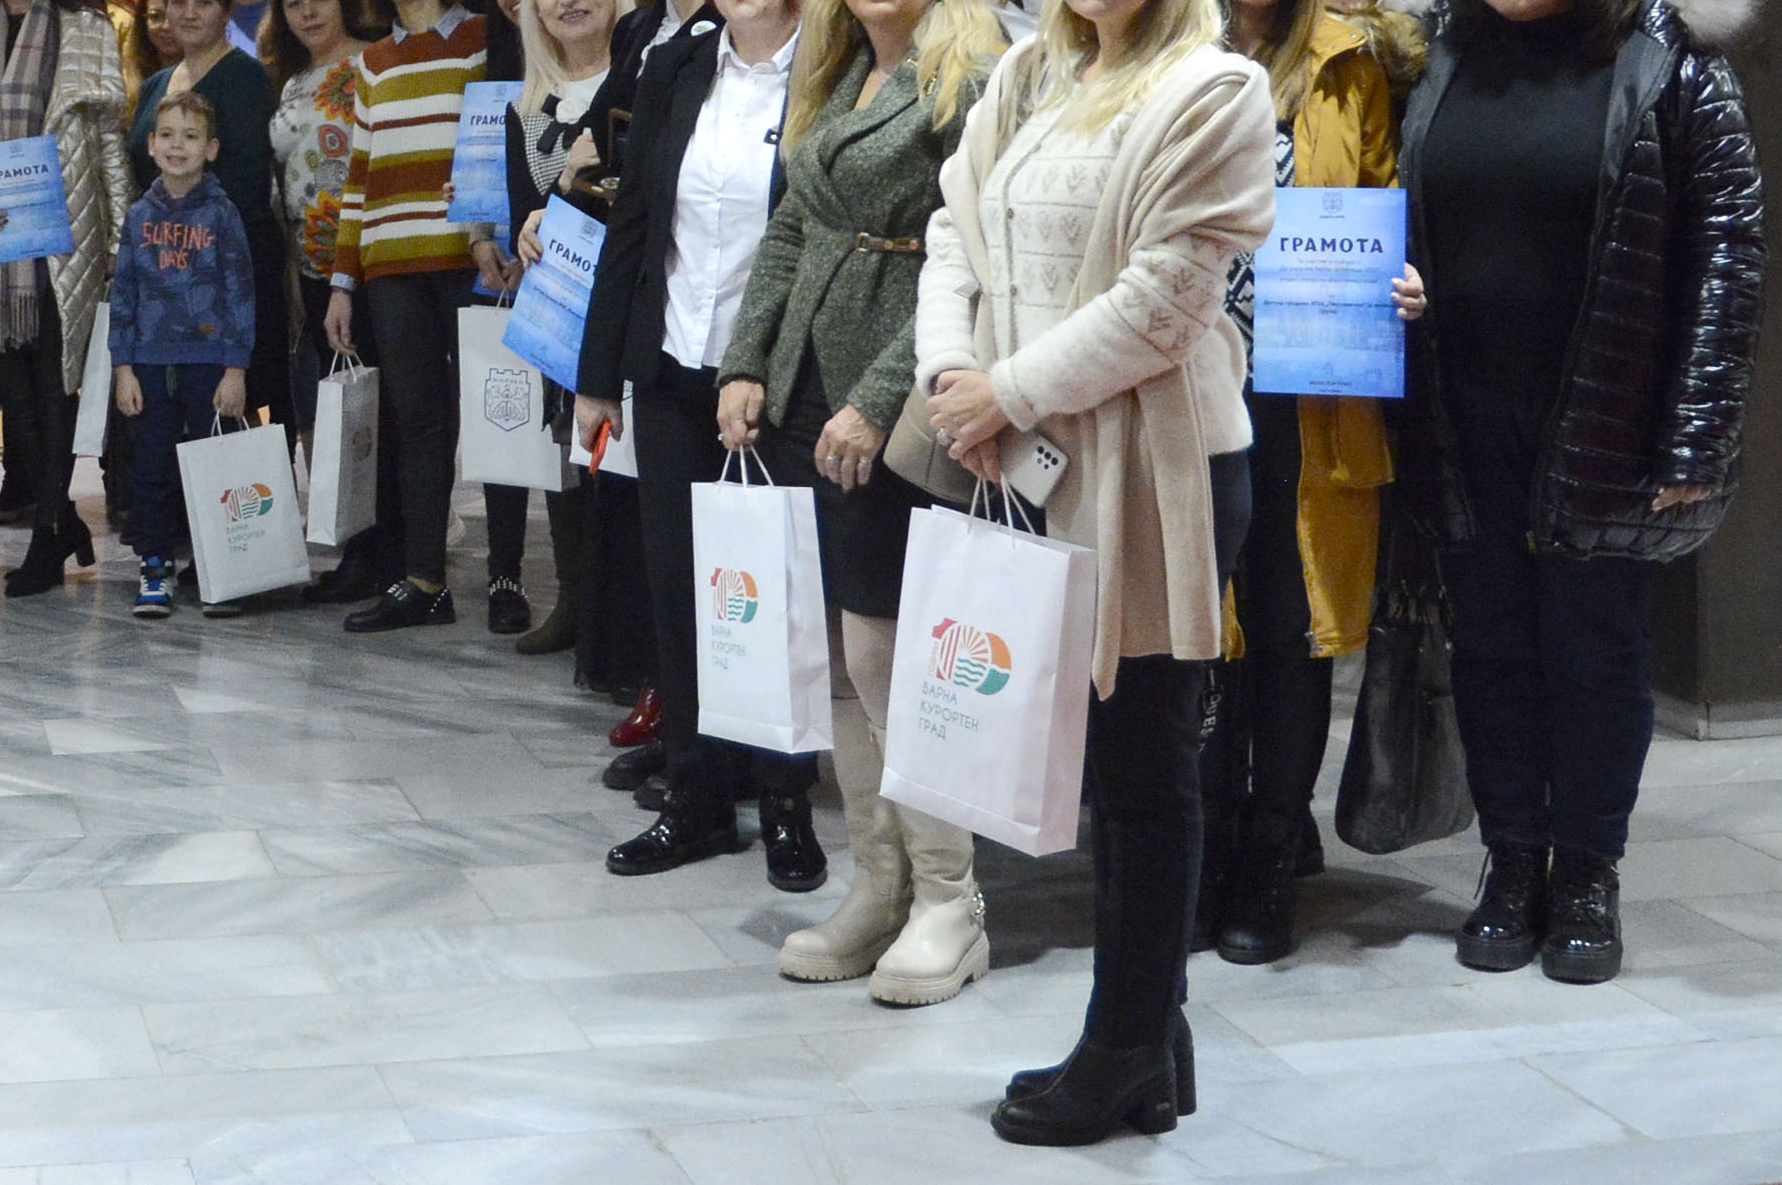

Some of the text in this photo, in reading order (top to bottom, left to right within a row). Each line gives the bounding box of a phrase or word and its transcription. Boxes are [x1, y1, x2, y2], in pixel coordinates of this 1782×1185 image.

[139, 221, 216, 251] SURFING
[1280, 237, 1384, 254] ГРАМОТА
[159, 248, 189, 270] DAYS
[922, 681, 958, 705] ВАРНА
[920, 700, 979, 732] КУРОРТЕН
[918, 717, 947, 741] ГРАД
